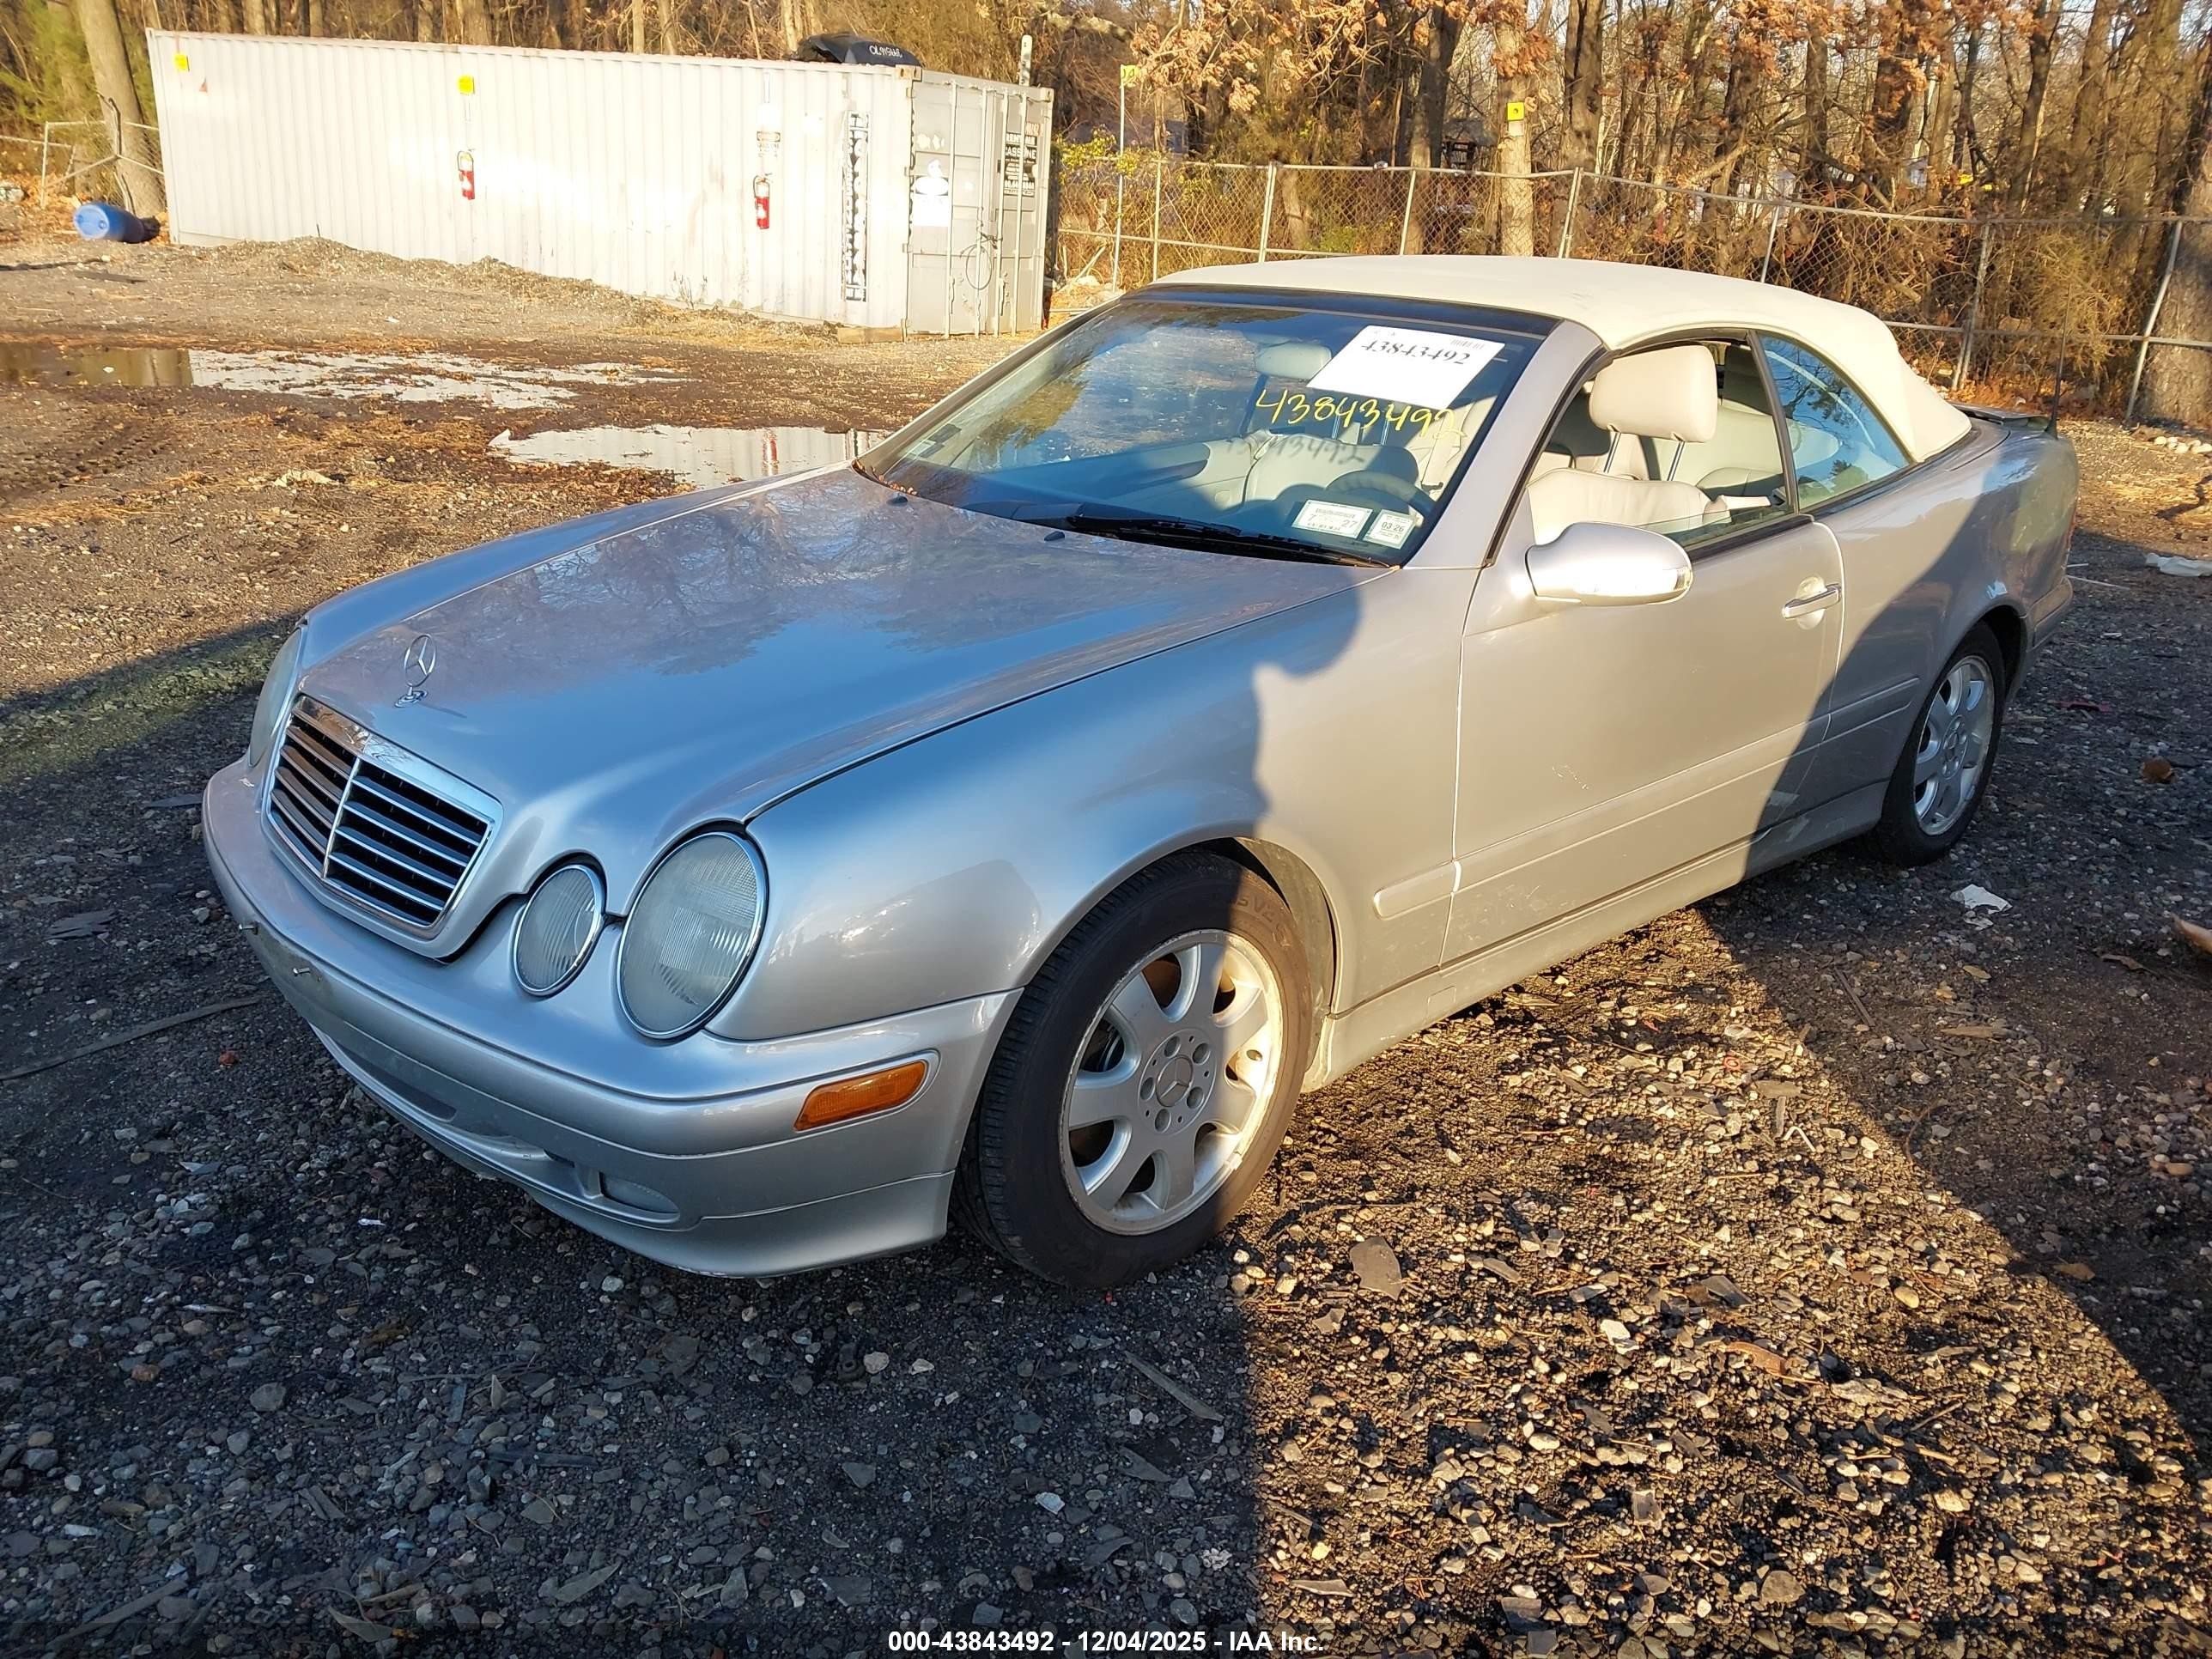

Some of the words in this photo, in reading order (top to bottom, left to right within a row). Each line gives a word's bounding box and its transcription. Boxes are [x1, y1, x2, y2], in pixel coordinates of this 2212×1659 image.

[1006, 146, 1036, 159] CASSNE
[1361, 340, 1471, 364] 43843492
[1255, 389, 1468, 441] 43843492
[1341, 520, 1358, 529] 27
